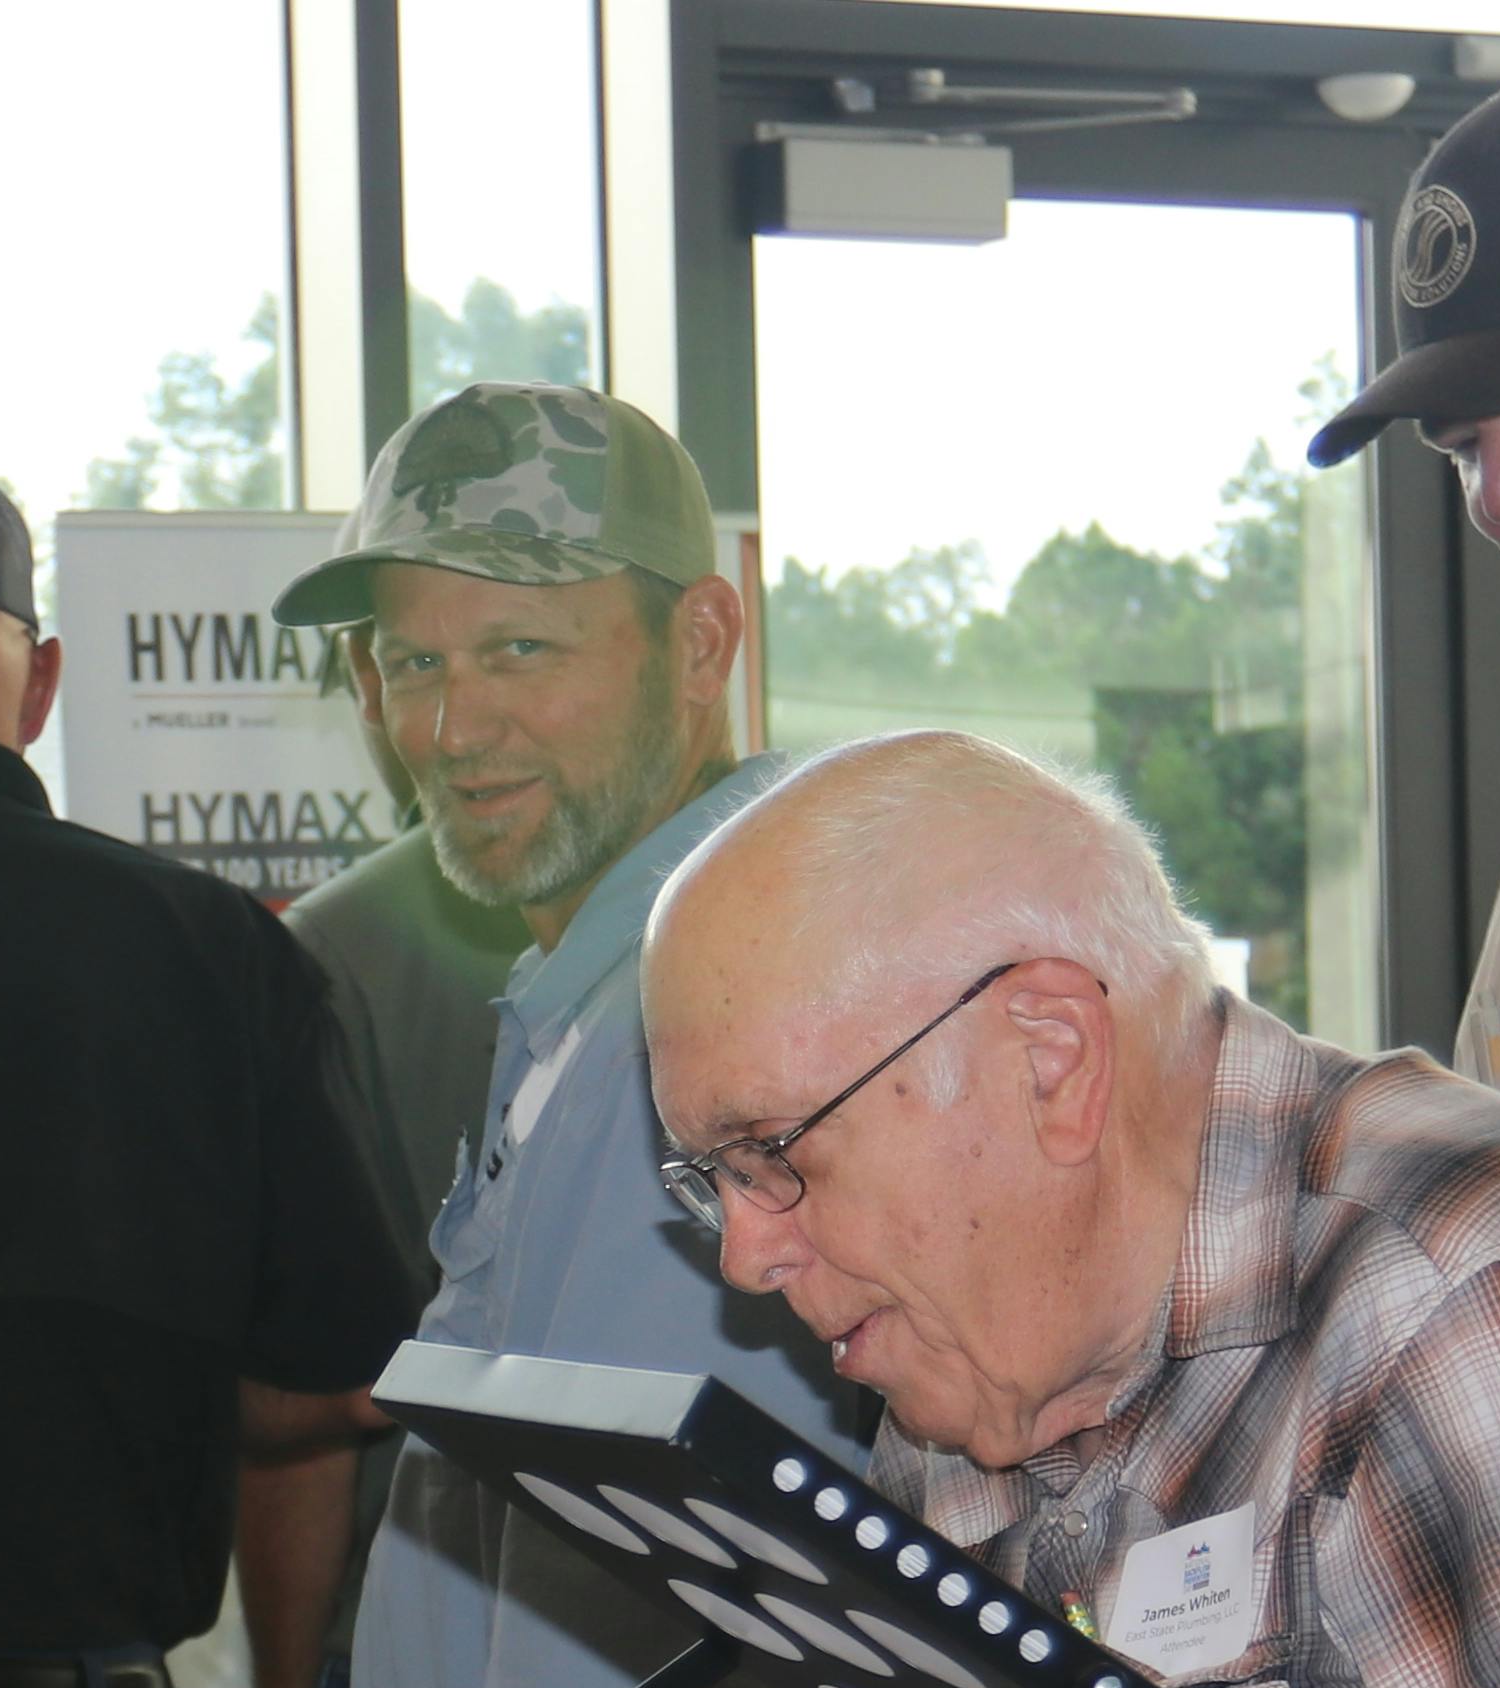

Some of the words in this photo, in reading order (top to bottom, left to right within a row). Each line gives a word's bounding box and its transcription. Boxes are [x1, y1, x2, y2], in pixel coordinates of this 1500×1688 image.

[147, 711, 229, 728] MUELLER
[142, 790, 375, 844] HYMAX
[1124, 1629, 1146, 1643] East
[1149, 1625, 1175, 1639] State
[1224, 1602, 1240, 1619] LLC
[1141, 1603, 1185, 1623] James
[1189, 1588, 1231, 1612] Whiten
